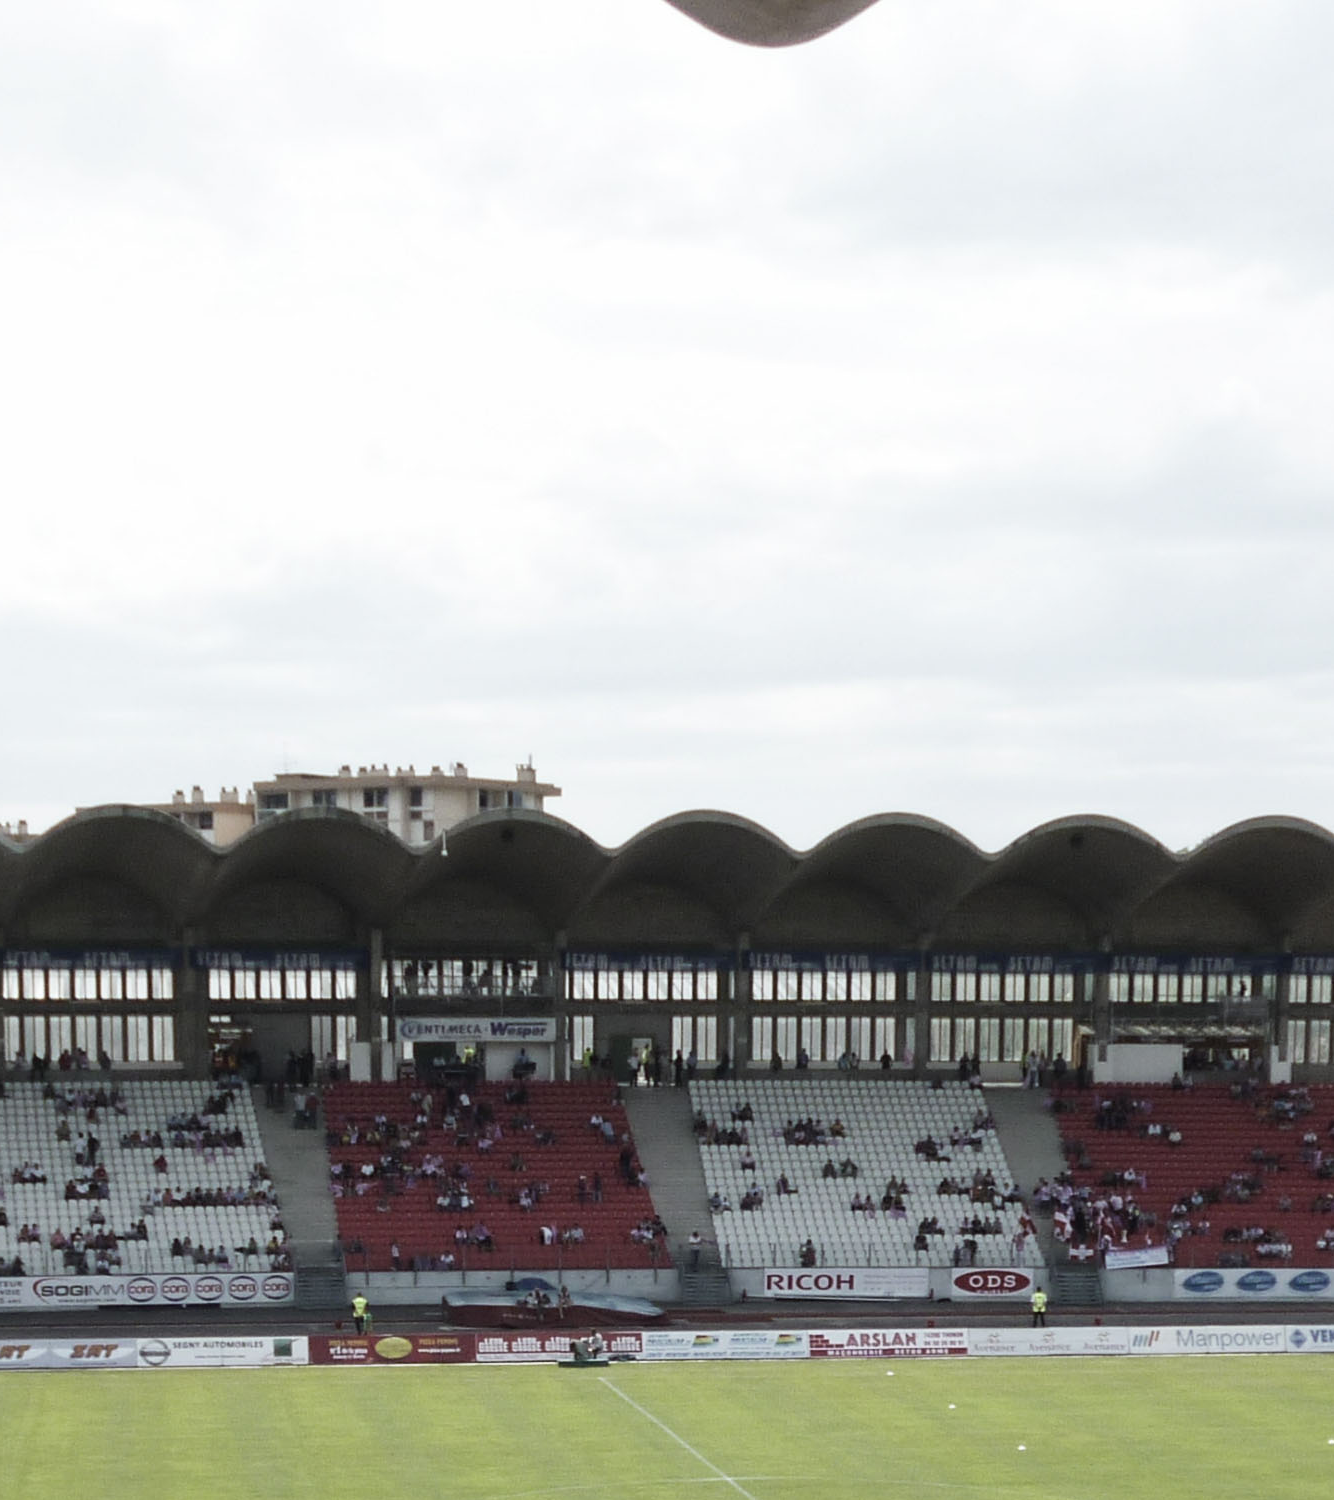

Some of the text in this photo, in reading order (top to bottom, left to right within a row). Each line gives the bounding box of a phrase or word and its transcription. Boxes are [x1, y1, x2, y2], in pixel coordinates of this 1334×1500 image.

[407, 1022, 548, 1038] VENTIMECA Wesper
[767, 1274, 855, 1290] RICOH
[969, 1275, 1017, 1288] ODS
[41, 1284, 125, 1297] SOGIMM
[129, 1284, 155, 1294] cora
[163, 1284, 188, 1293] cora
[197, 1284, 223, 1293] cora
[230, 1283, 256, 1292] cora
[263, 1283, 290, 1292] cora
[203, 1341, 264, 1349] AUTOMOBILES
[846, 1333, 917, 1347] ARSLAN
[1176, 1330, 1282, 1351] Manpower
